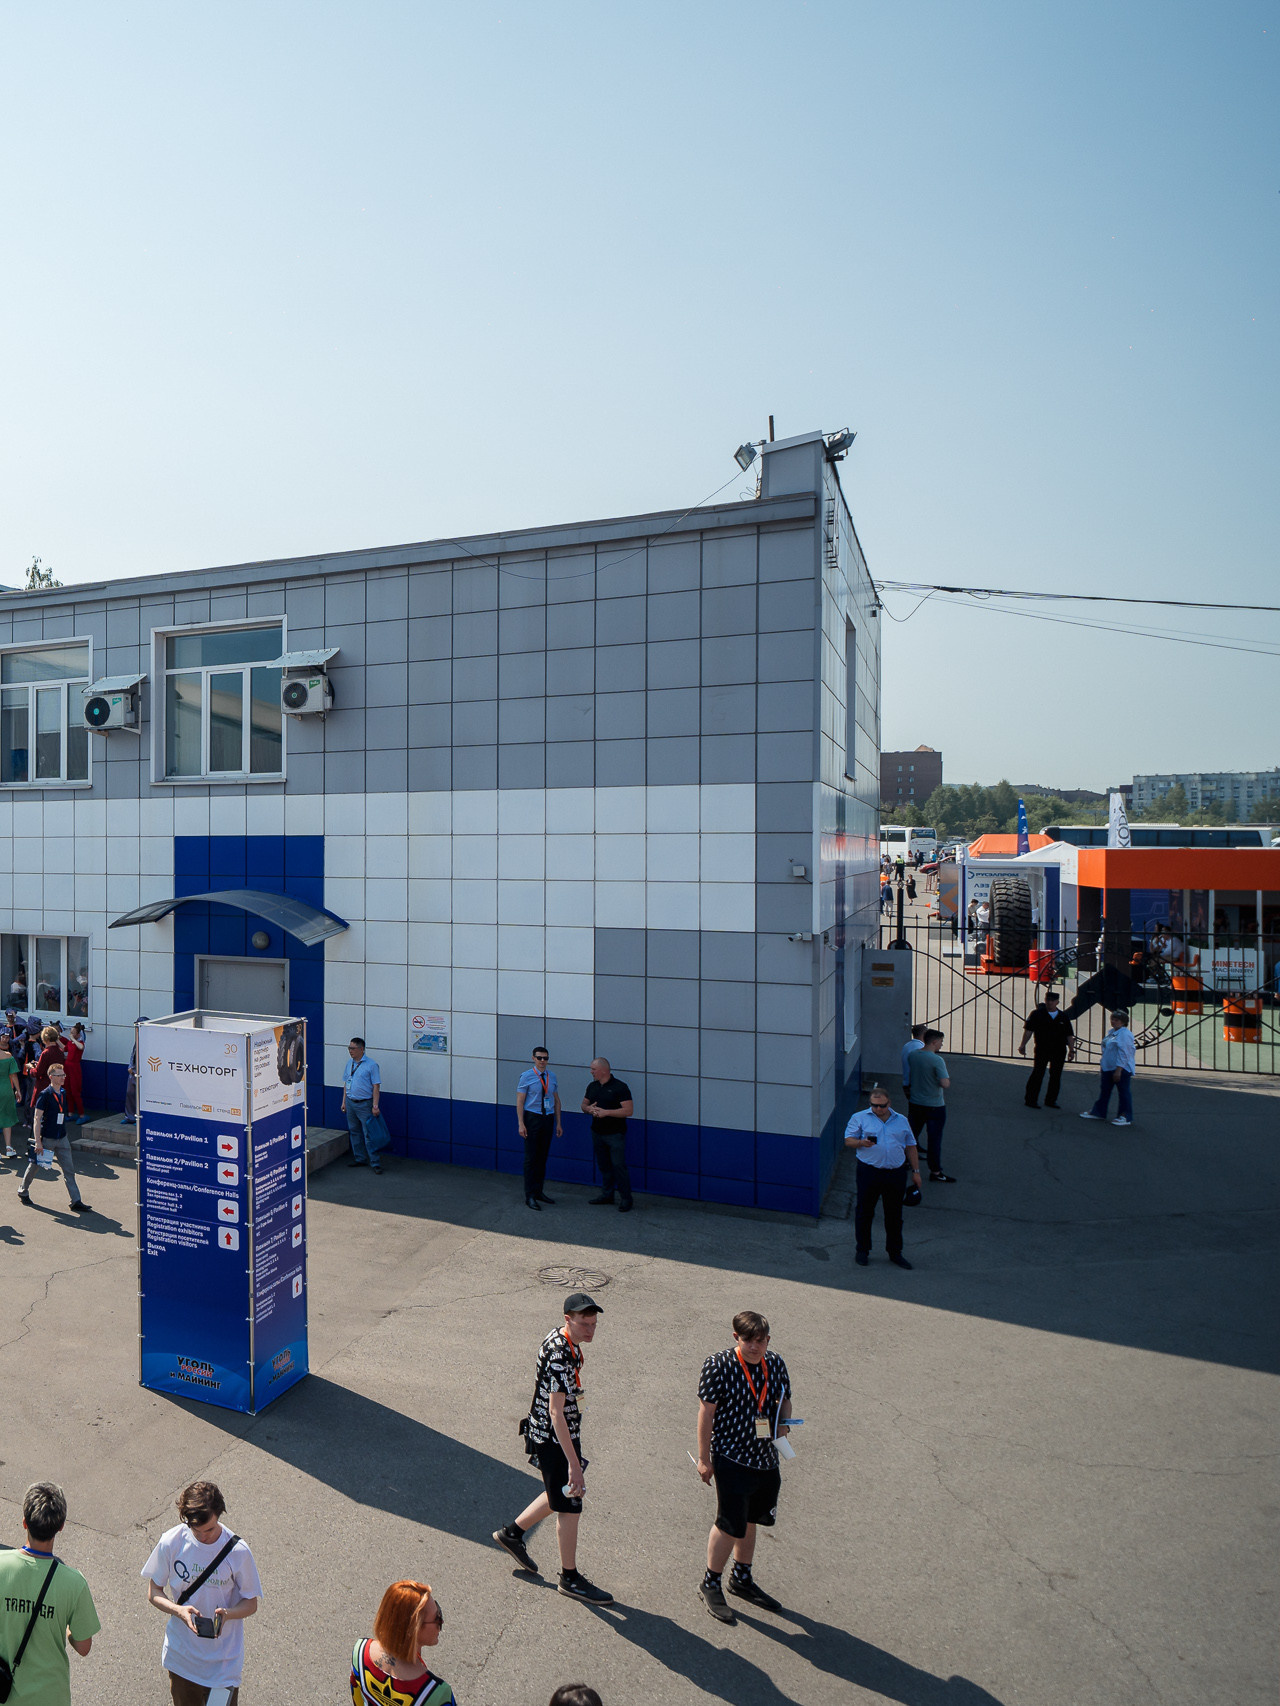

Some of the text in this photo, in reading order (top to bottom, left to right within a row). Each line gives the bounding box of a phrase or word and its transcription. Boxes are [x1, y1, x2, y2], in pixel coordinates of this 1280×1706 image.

[224, 1043, 238, 1055] 30
[168, 1061, 237, 1077] ТЕХНОТОРГ
[145, 1128, 173, 1138] Павильон
[174, 1133, 203, 1143] 1/Pavilion
[146, 1153, 173, 1163] Павильон
[174, 1158, 203, 1169] 2/Pavilion
[225, 1190, 239, 1199] Halls
[147, 1214, 210, 1231] Регистрация участников
[147, 1221, 203, 1237] Registration exhibitors
[147, 1233, 197, 1249] Registration visitors
[147, 1242, 166, 1252] Выход
[177, 1355, 214, 1373] УГОЛЬ
[181, 1364, 213, 1378] РОССИИ
[177, 1372, 221, 1390] МАЙНИНГ
[192, 1564, 218, 1575] Дыи
